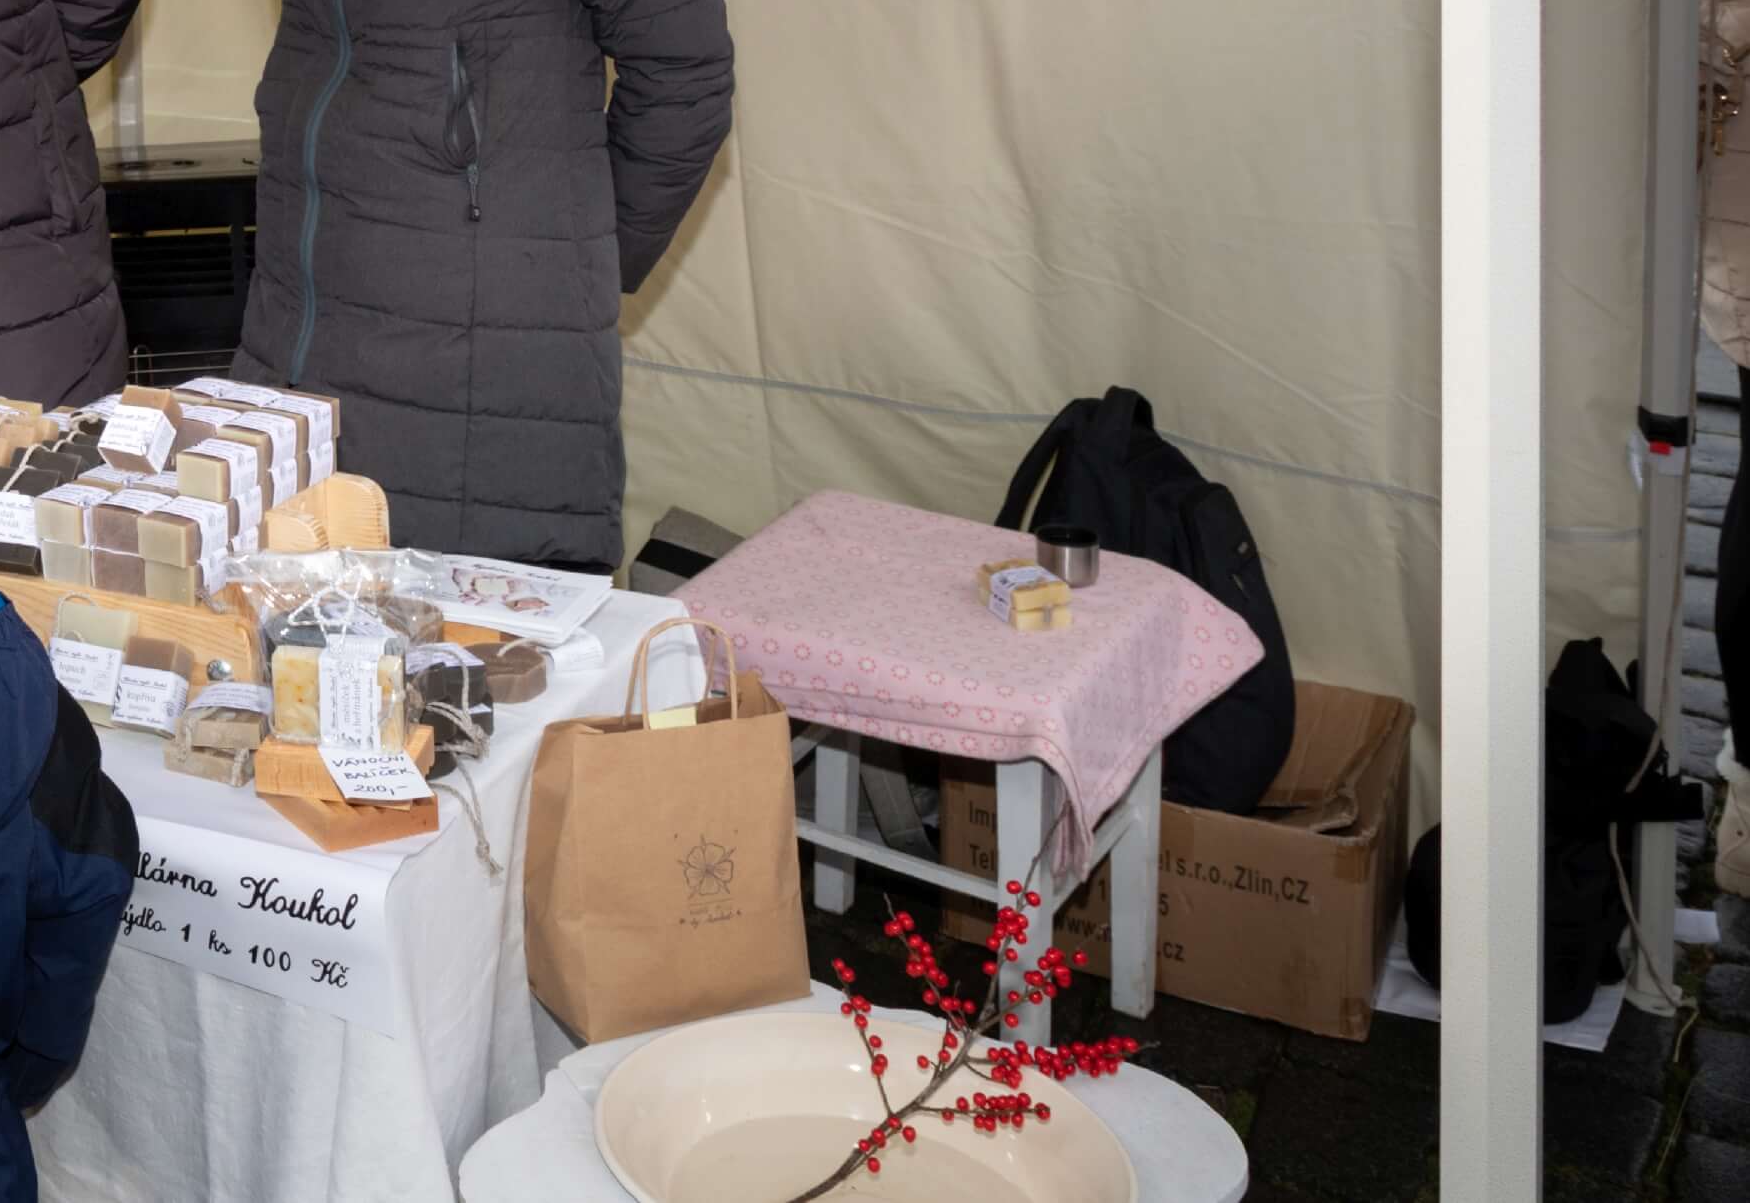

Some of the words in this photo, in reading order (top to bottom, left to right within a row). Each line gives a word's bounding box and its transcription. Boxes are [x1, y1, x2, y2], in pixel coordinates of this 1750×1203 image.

[134, 852, 217, 897] lárna
[237, 876, 358, 930] Koukol
[180, 923, 191, 942] 1
[208, 930, 232, 955] ks
[248, 944, 291, 971] 100
[311, 958, 349, 988] Kč
